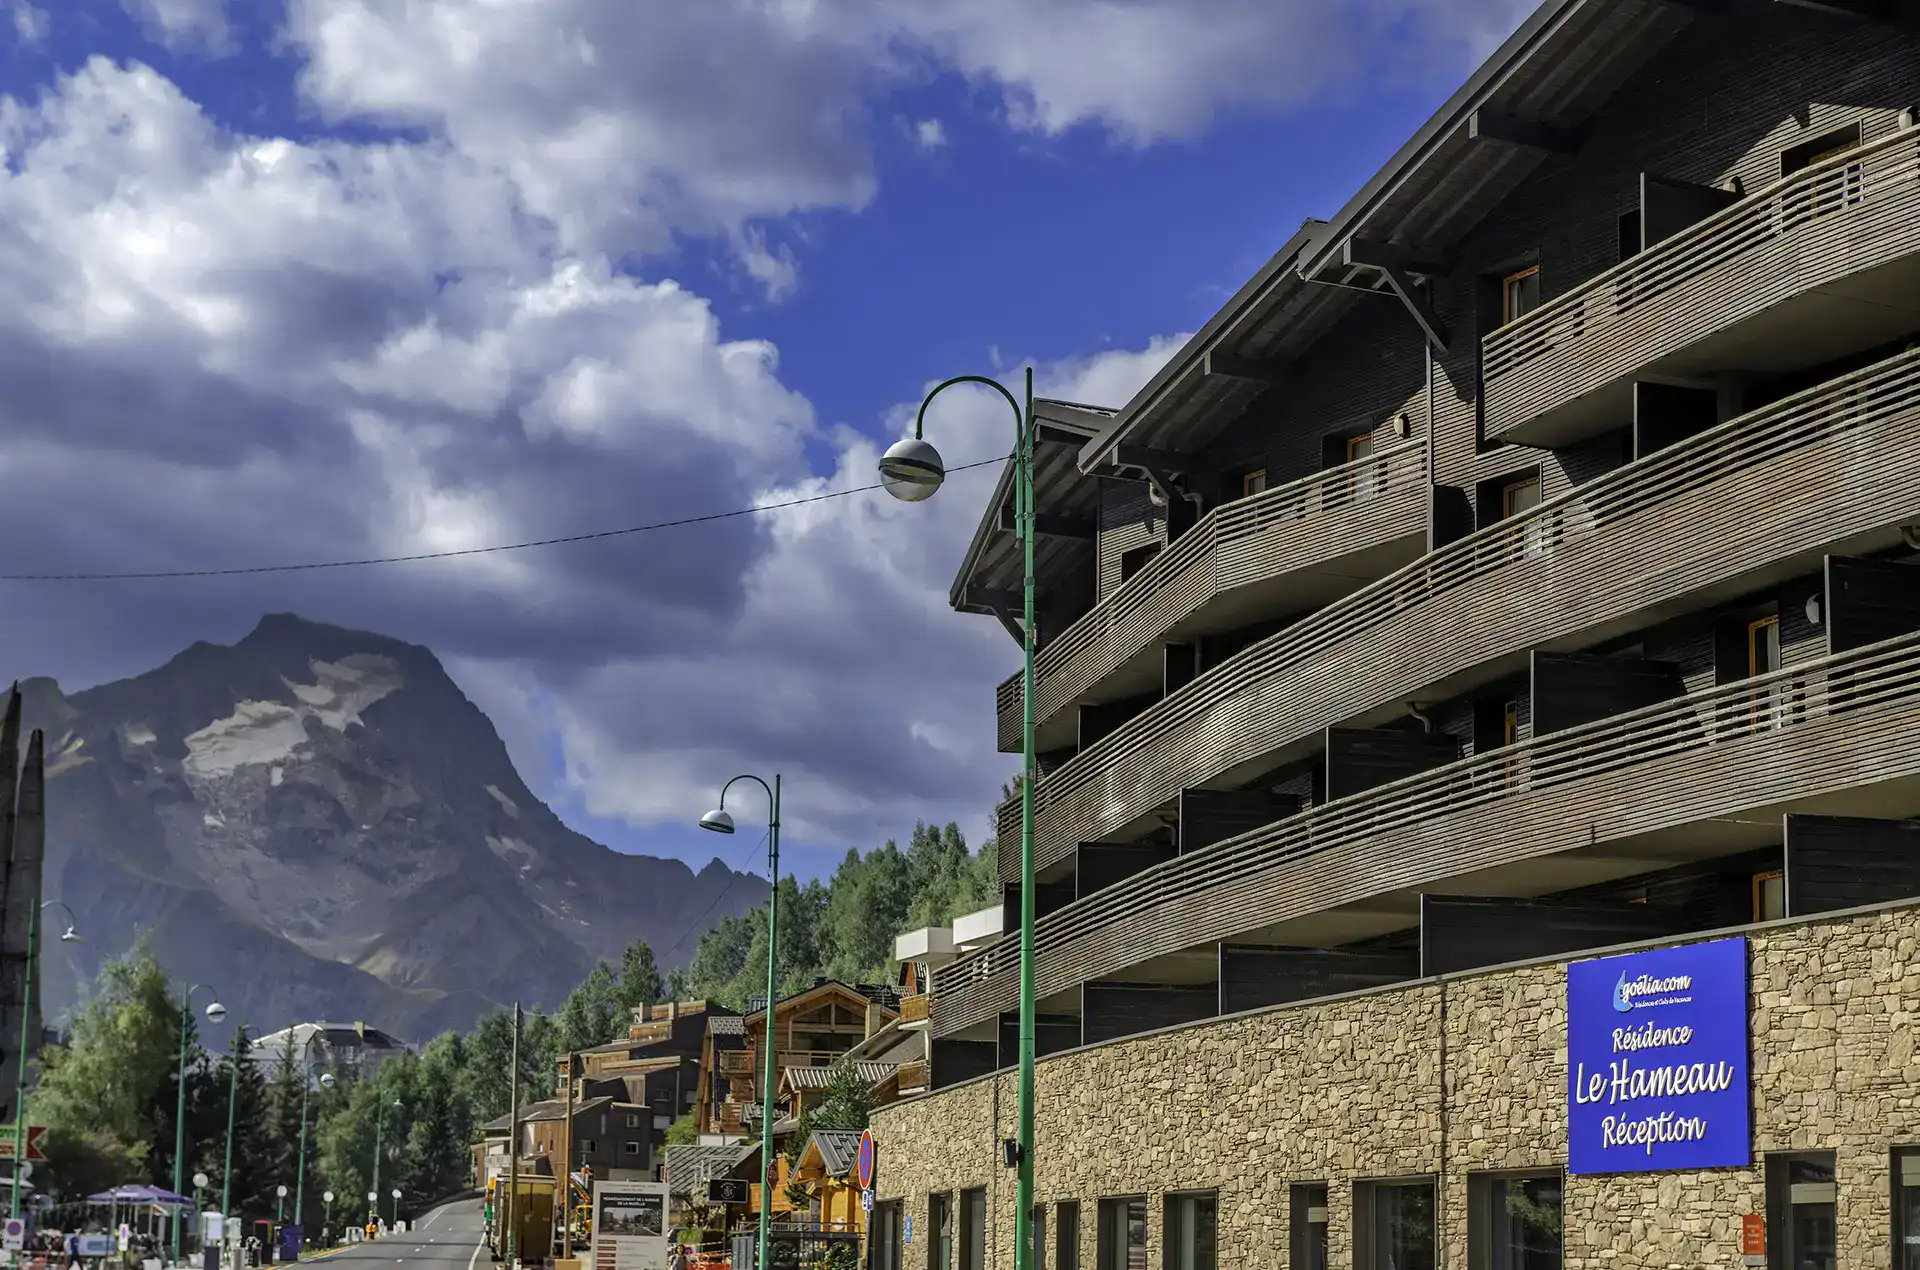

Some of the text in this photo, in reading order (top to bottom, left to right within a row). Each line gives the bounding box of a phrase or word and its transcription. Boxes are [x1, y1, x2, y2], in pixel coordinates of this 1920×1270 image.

[1612, 1021, 1694, 1053] Résidence
[1576, 1058, 1734, 1105] Le Hameau
[1602, 1110, 1707, 1155] Réception
